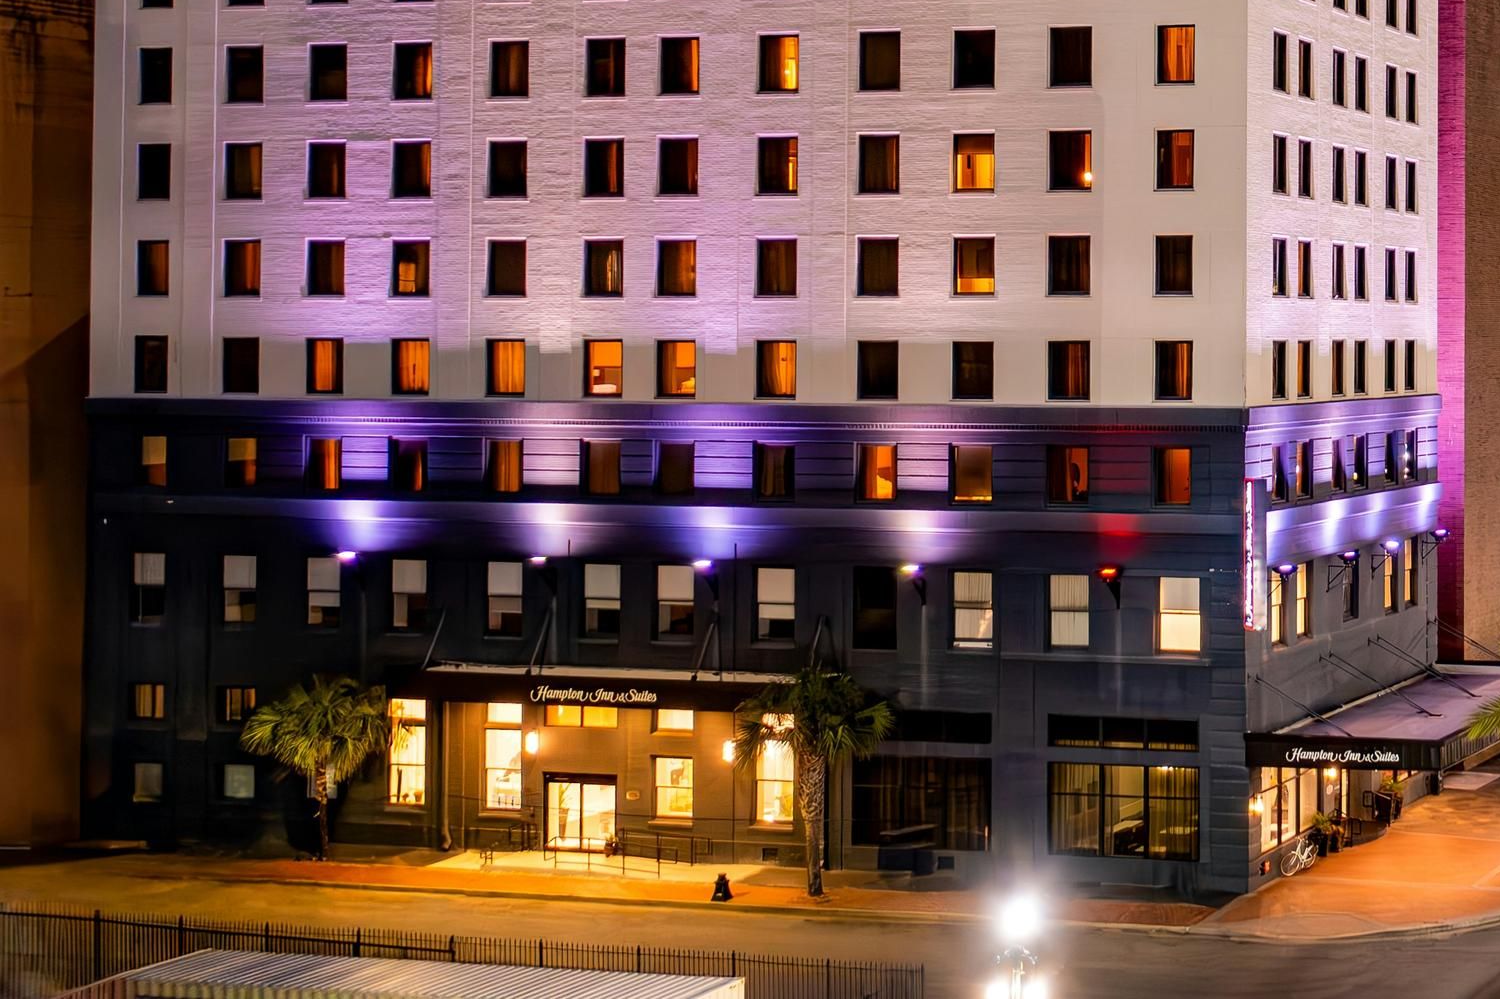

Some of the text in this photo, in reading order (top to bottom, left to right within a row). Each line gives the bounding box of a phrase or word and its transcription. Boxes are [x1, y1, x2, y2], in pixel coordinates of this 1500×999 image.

[530, 685, 657, 703] Hampton Inn & Suites
[1286, 747, 1400, 763] Hampton Inn & Suites
